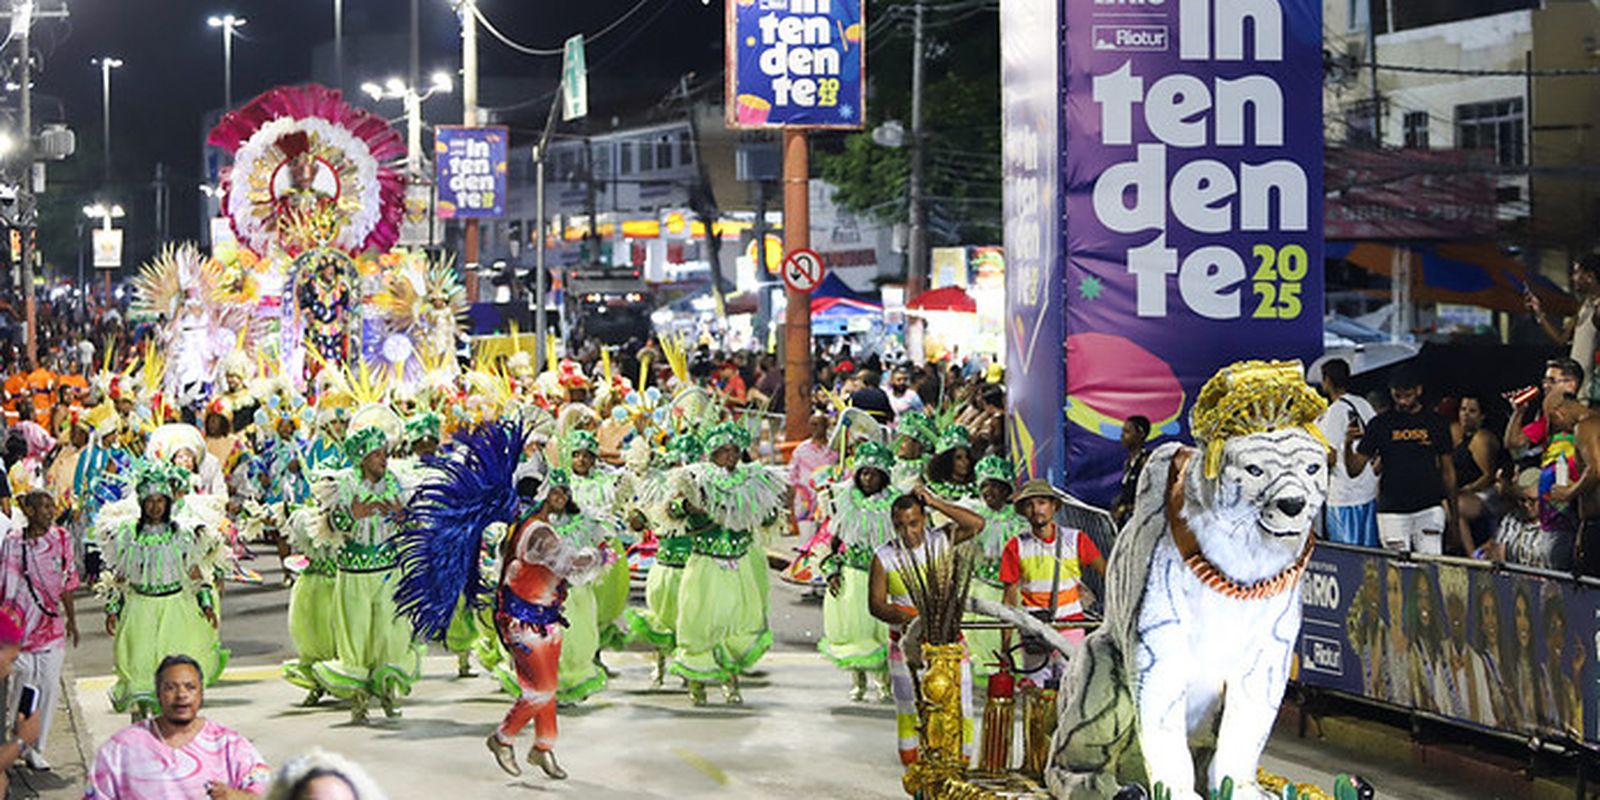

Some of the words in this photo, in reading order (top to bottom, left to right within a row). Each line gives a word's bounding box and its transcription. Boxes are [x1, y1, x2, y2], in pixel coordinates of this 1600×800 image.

[759, 11, 831, 45] ten
[1116, 29, 1165, 46] Riotur
[759, 40, 840, 76] den
[772, 74, 817, 107] te
[1093, 58, 1284, 147] ten
[1093, 143, 1308, 234] den
[1127, 230, 1247, 320] te
[1252, 244, 1309, 281] 20
[1252, 282, 1303, 319] 25
[1391, 429, 1429, 441] BOSS
